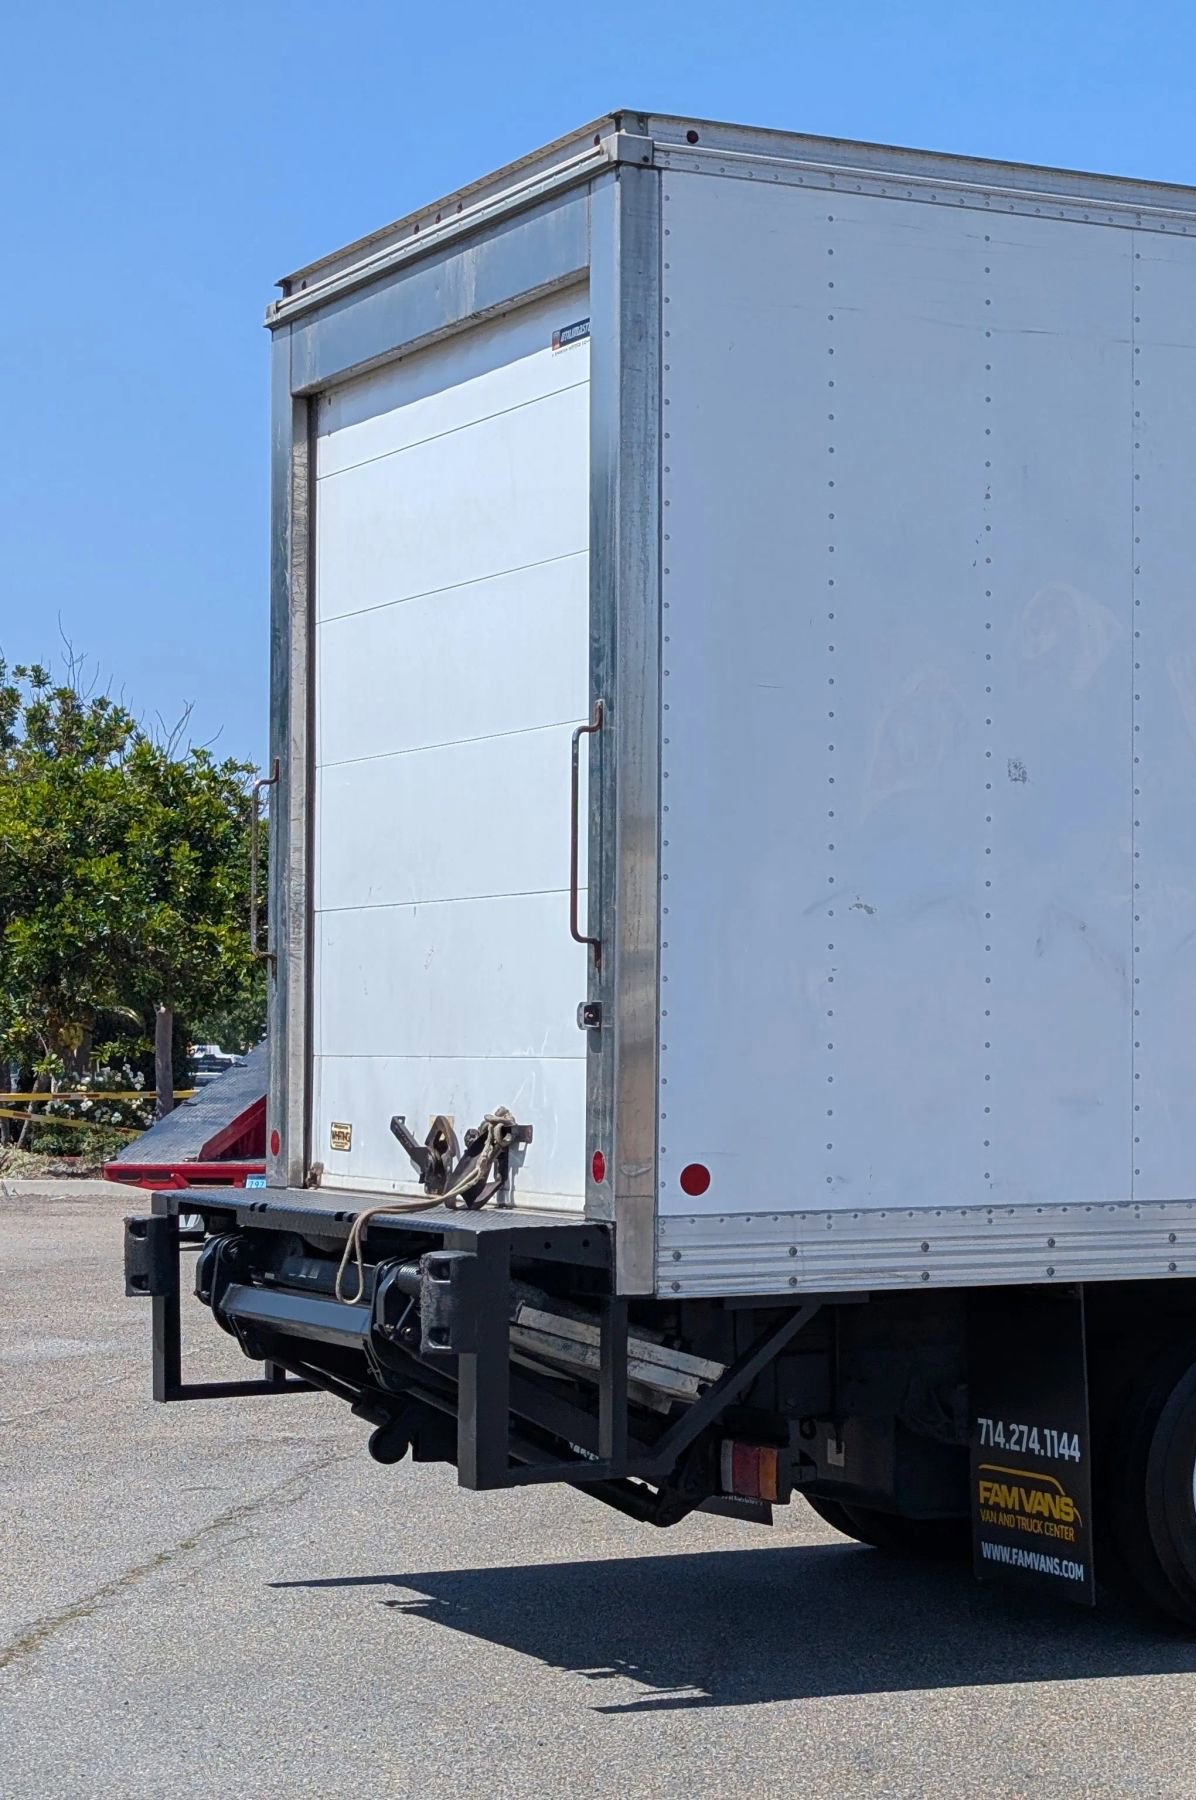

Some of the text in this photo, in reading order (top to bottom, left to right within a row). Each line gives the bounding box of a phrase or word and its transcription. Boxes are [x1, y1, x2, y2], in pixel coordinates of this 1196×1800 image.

[977, 1417, 1081, 1463] 714.274.1144
[980, 1508, 1075, 1542] VAN AND TRUCK CENTER
[981, 1541, 1084, 1582] WWW.FAMVANS.COM
